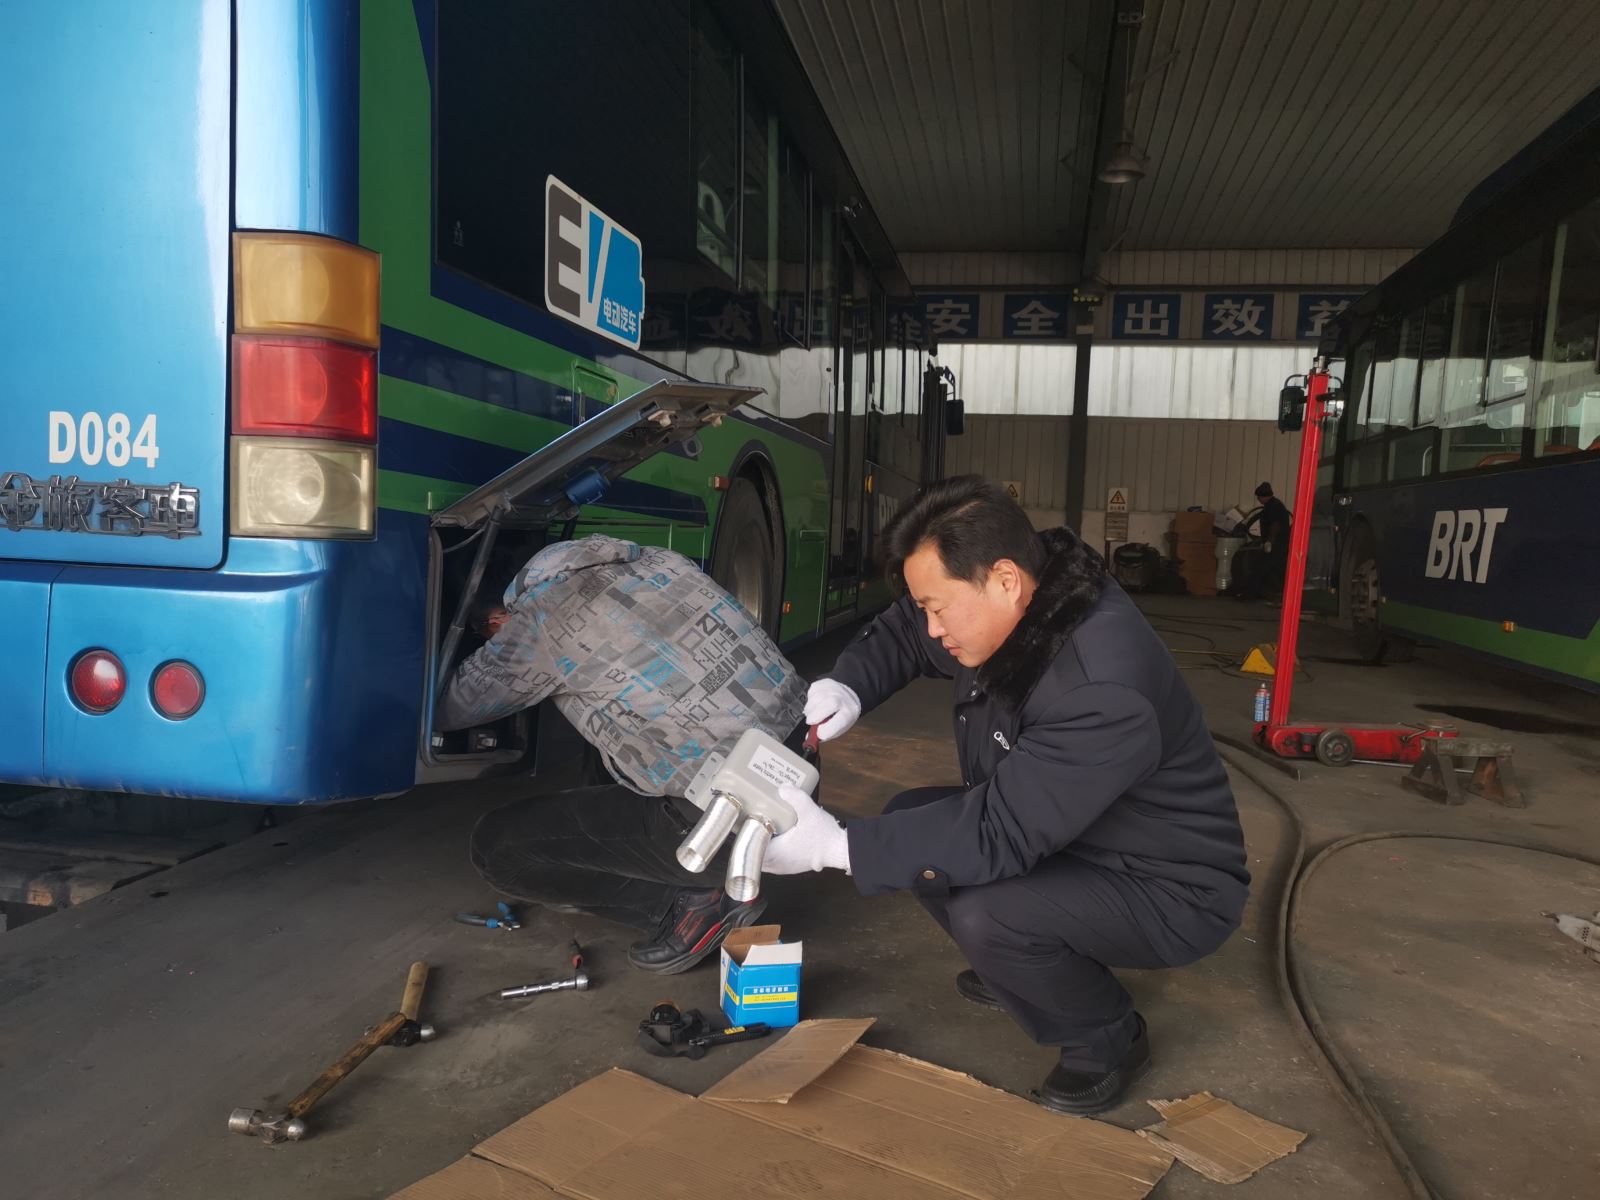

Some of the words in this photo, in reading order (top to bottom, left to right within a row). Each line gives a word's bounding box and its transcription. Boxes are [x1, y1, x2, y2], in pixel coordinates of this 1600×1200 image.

[548, 184, 606, 318] EV
[604, 298, 637, 334] 电动汽车
[49, 411, 159, 467] D084
[1425, 508, 1508, 583] BRT
[549, 599, 598, 649] HOT
[674, 694, 721, 734] HOT
